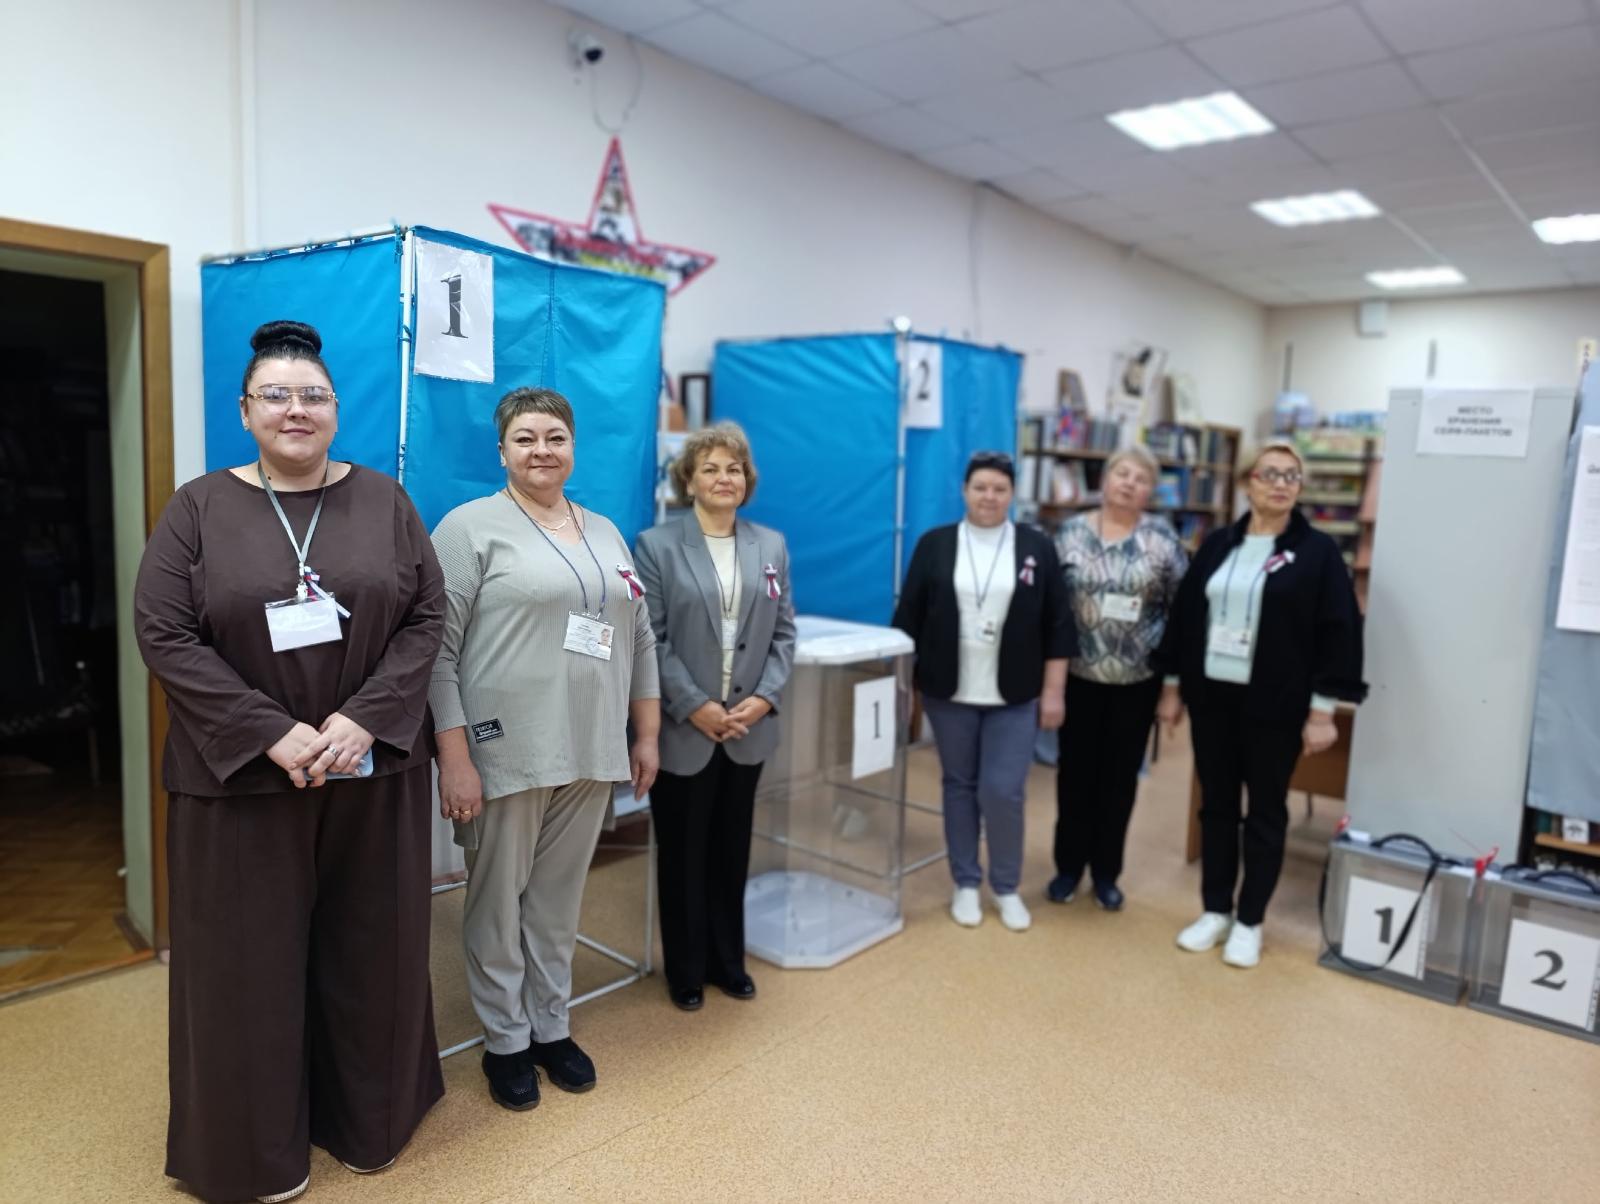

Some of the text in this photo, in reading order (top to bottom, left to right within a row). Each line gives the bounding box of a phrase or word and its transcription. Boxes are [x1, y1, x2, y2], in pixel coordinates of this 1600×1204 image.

[440, 274, 469, 339] 1
[917, 358, 930, 401] 2
[1457, 405, 1494, 415] МЕСТО
[872, 700, 882, 740] 1
[1374, 906, 1394, 945] 1
[1530, 949, 1567, 991] 2
